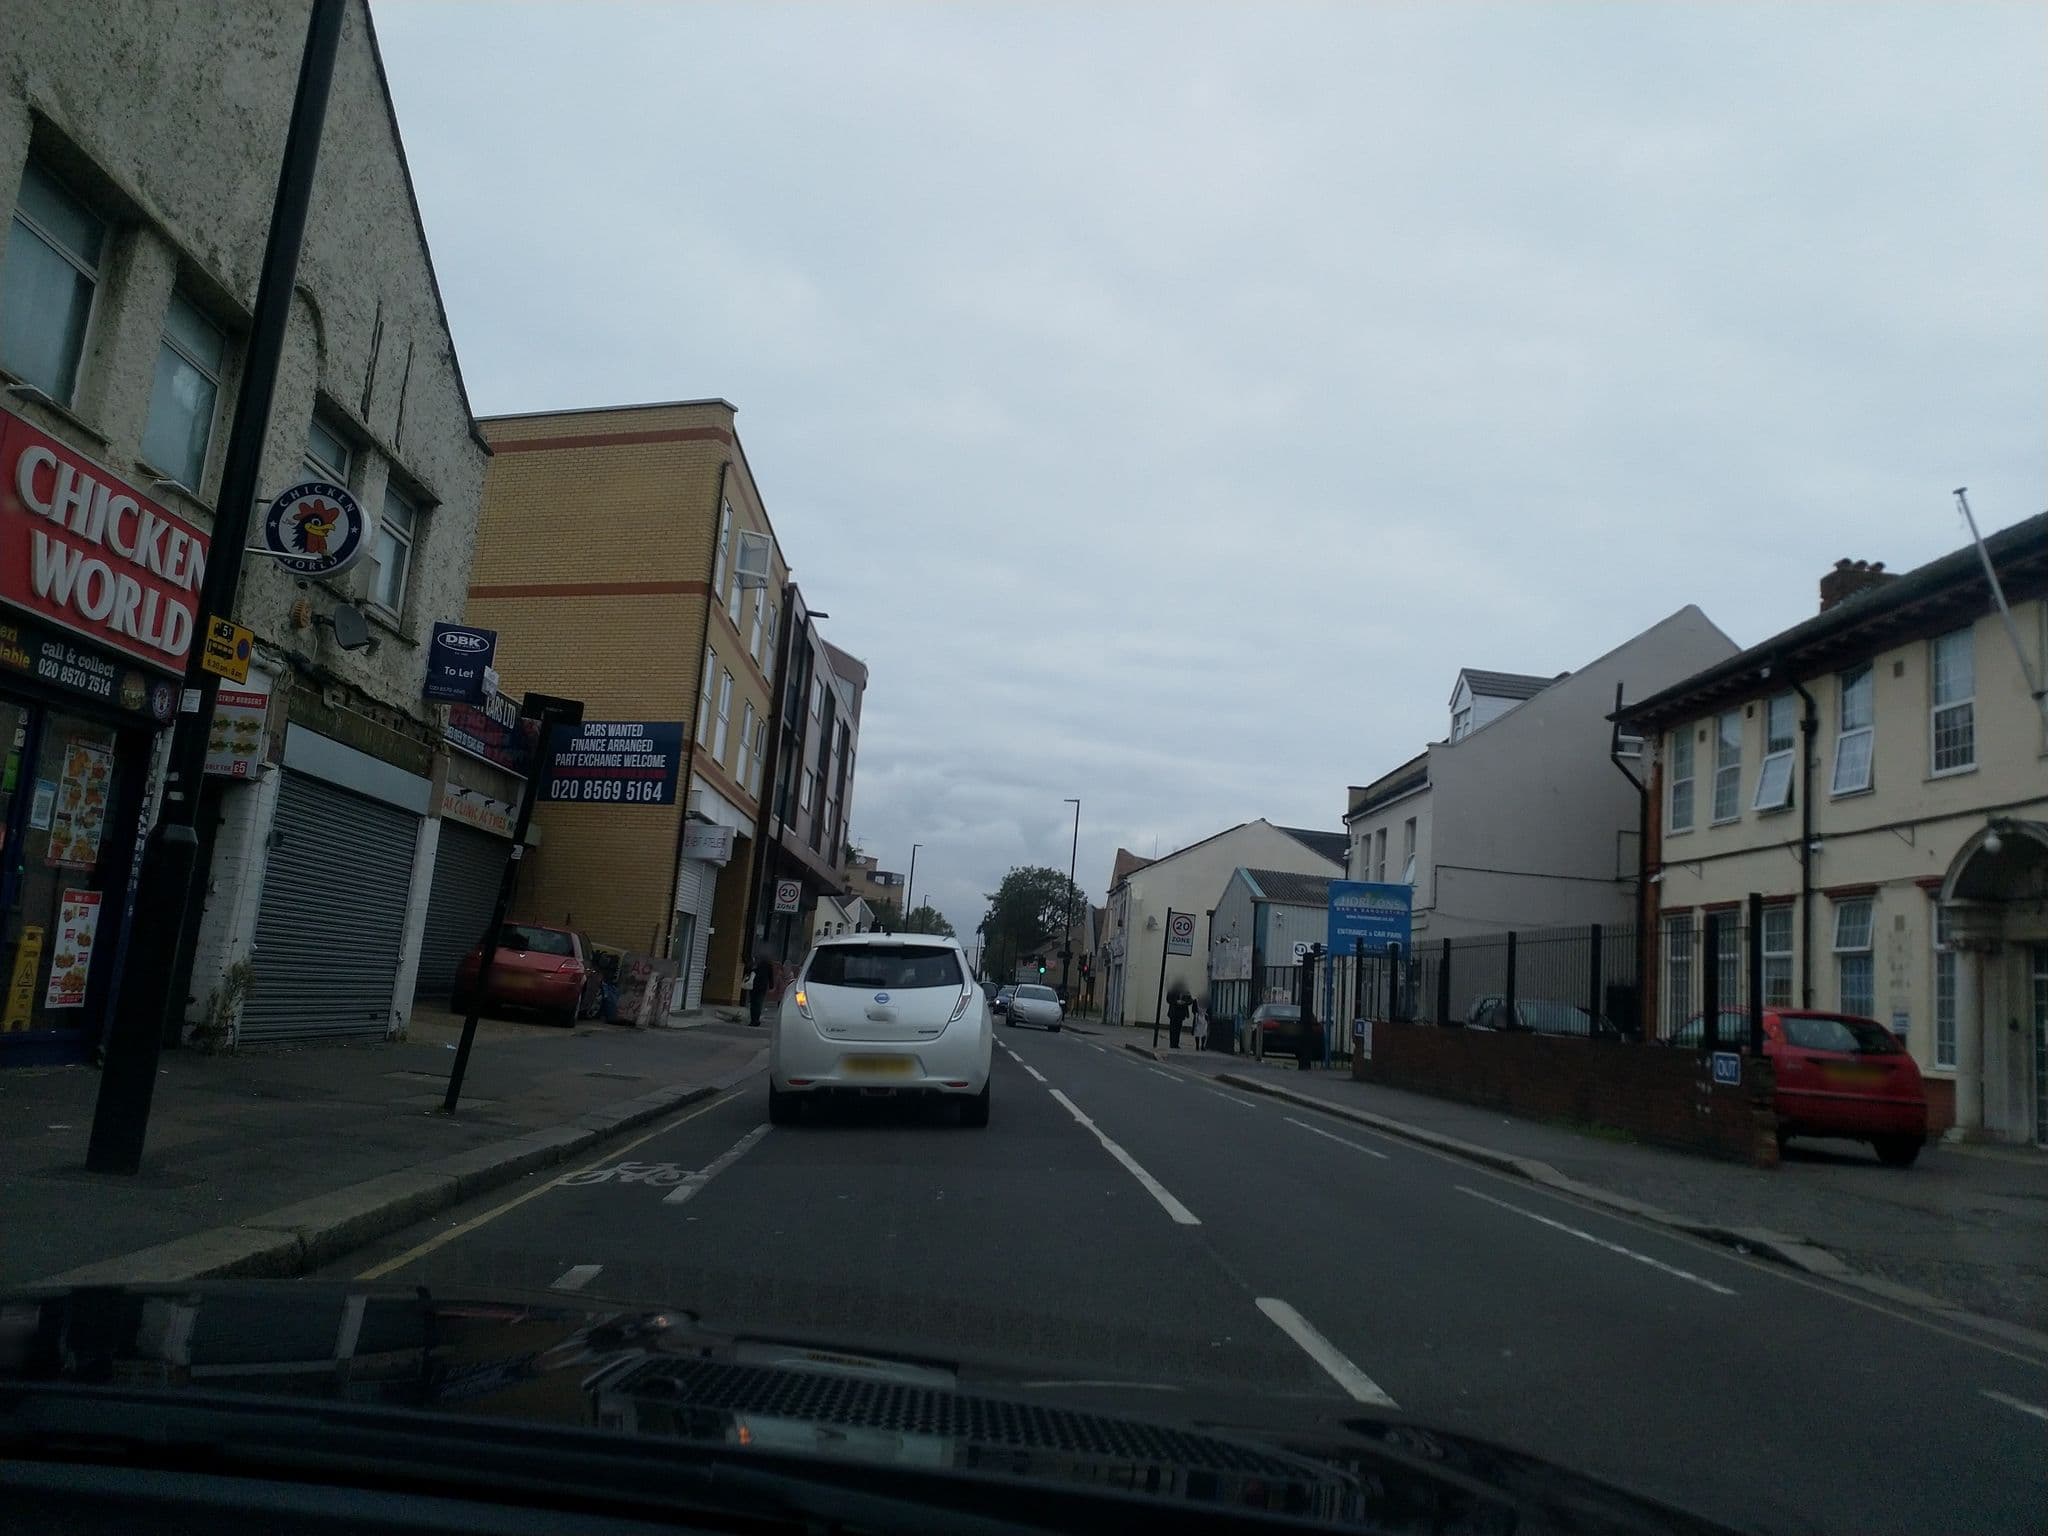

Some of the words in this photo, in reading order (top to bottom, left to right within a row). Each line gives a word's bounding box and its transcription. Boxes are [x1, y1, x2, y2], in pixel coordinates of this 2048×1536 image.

[280, 485, 356, 513] CHICKEN
[15, 446, 206, 592] CHICKEN
[31, 528, 193, 656] WORLD
[445, 634, 481, 647] DBK
[41, 642, 65, 661] call
[66, 650, 77, 665] &
[78, 655, 116, 678] collect
[38, 658, 59, 679] 020
[60, 661, 87, 688] 8570
[87, 675, 112, 696] 7514
[445, 665, 456, 675] To
[459, 668, 474, 678] Let
[486, 696, 503, 724] CARS
[503, 701, 516, 730] LTD
[584, 724, 607, 737] CARS
[607, 724, 644, 737] WANTED
[570, 739, 606, 752] FINANCE
[607, 739, 653, 752] ARRANGED
[233, 762, 246, 773] £5
[555, 754, 578, 767] PART
[578, 754, 622, 767] EXCHANGE
[624, 755, 667, 768] WELCOME
[551, 779, 579, 799] 020
[583, 780, 622, 801] 8569
[626, 781, 663, 802] 5164
[781, 888, 795, 897] 20
[1176, 921, 1190, 931] 20
[1337, 928, 1367, 936] ENTRANCE
[1717, 1059, 1737, 1078] OUT
